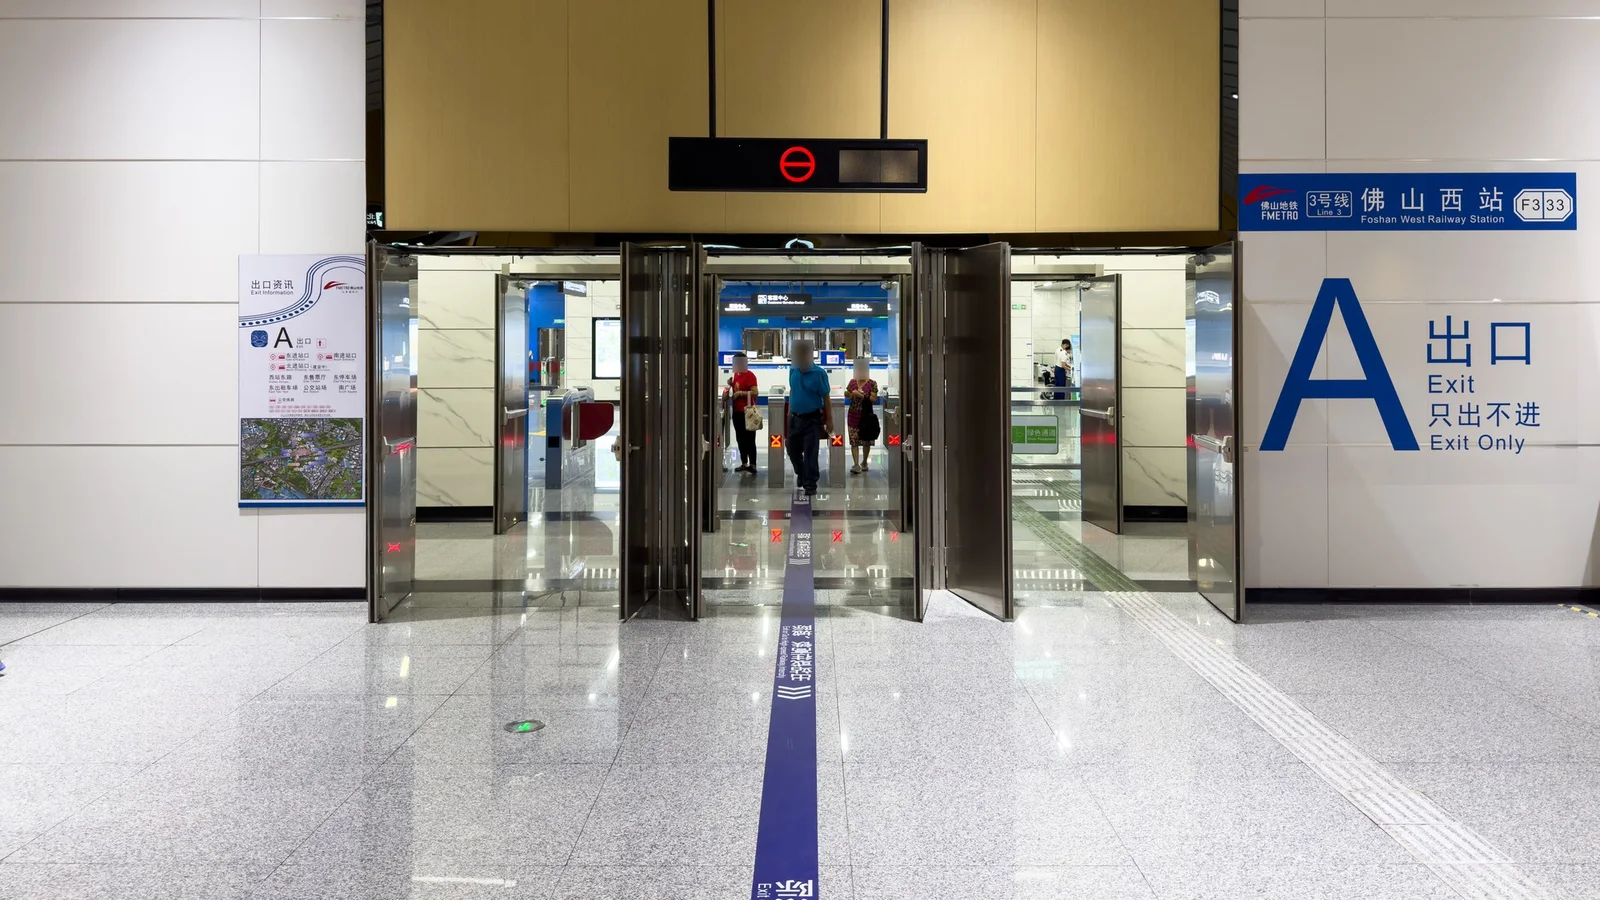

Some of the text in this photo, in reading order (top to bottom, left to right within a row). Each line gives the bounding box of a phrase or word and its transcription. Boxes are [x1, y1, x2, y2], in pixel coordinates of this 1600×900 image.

[1260, 201, 1299, 210] 佛山地铁
[1309, 193, 1350, 208] 3号线
[1361, 187, 1503, 212] 佛山西站
[1521, 199, 1565, 211] F3 33
[1261, 211, 1299, 221] FMETRO
[1361, 215, 1505, 225] Foshan West Railway Station
[251, 280, 294, 290] 出口资讯
[274, 327, 293, 348] A
[296, 337, 312, 345] 出口
[1427, 315, 1530, 367] 出口
[1259, 278, 1421, 451] A
[1429, 375, 1475, 394] Exit
[1429, 402, 1541, 428] 只出不进
[1430, 434, 1525, 455] Exit Only
